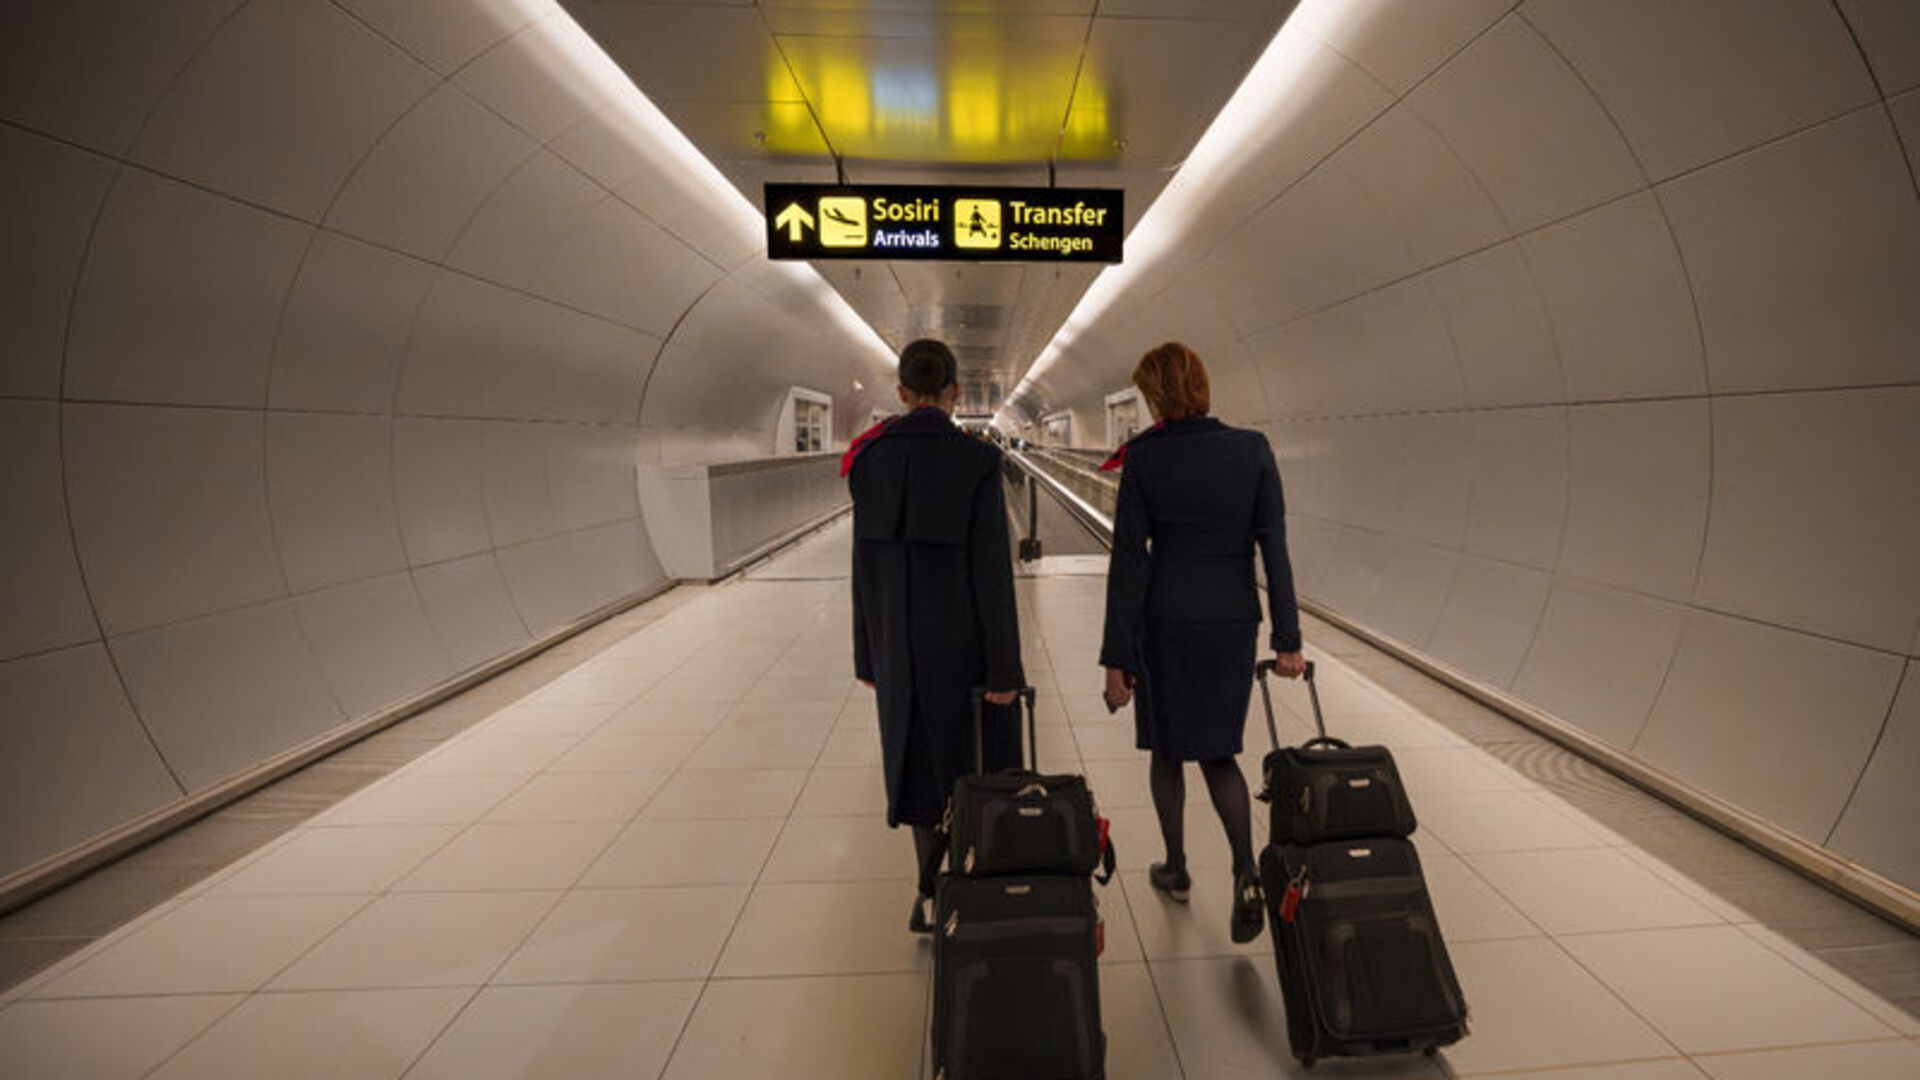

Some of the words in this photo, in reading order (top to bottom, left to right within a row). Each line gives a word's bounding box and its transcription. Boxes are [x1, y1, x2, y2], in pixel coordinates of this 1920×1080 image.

[872, 197, 940, 222] Sosiri
[1009, 201, 1107, 226] Transfer
[873, 229, 940, 248] Arrivals
[1009, 232, 1093, 255] Schengen
